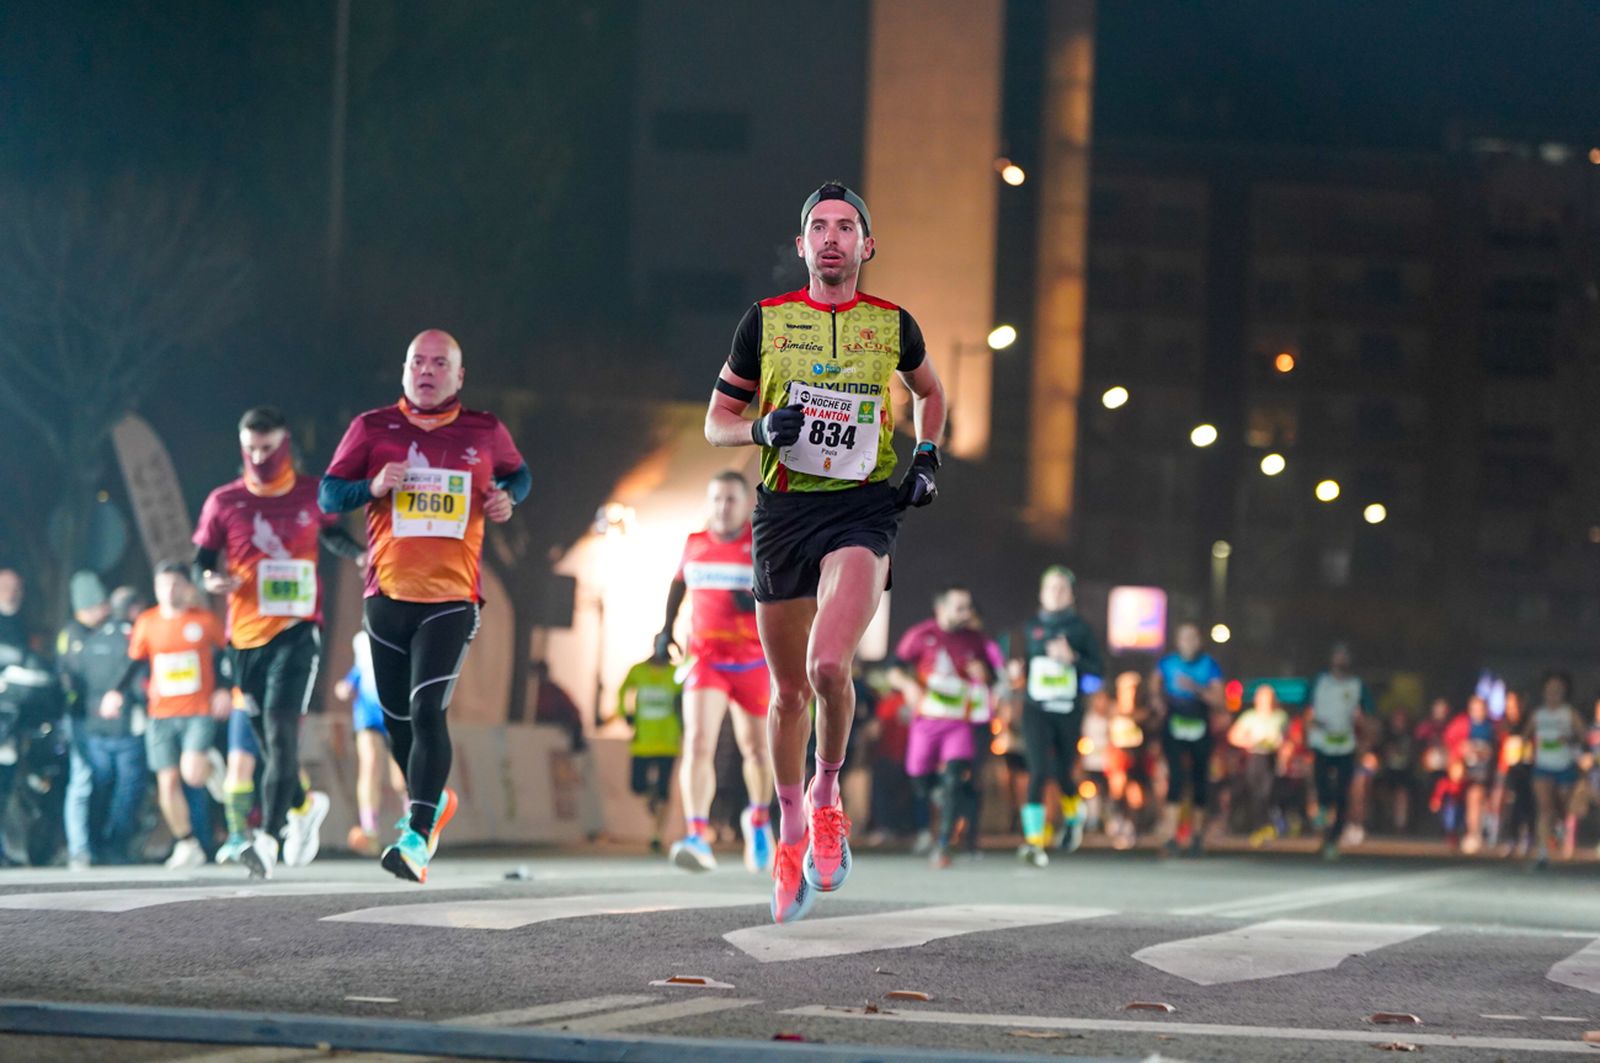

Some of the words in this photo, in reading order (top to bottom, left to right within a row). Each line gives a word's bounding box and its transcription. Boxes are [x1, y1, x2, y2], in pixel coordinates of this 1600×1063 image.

[810, 397, 839, 409] NOCHE
[840, 402, 852, 412] DE
[809, 420, 857, 450] 834
[407, 493, 454, 514] 7660
